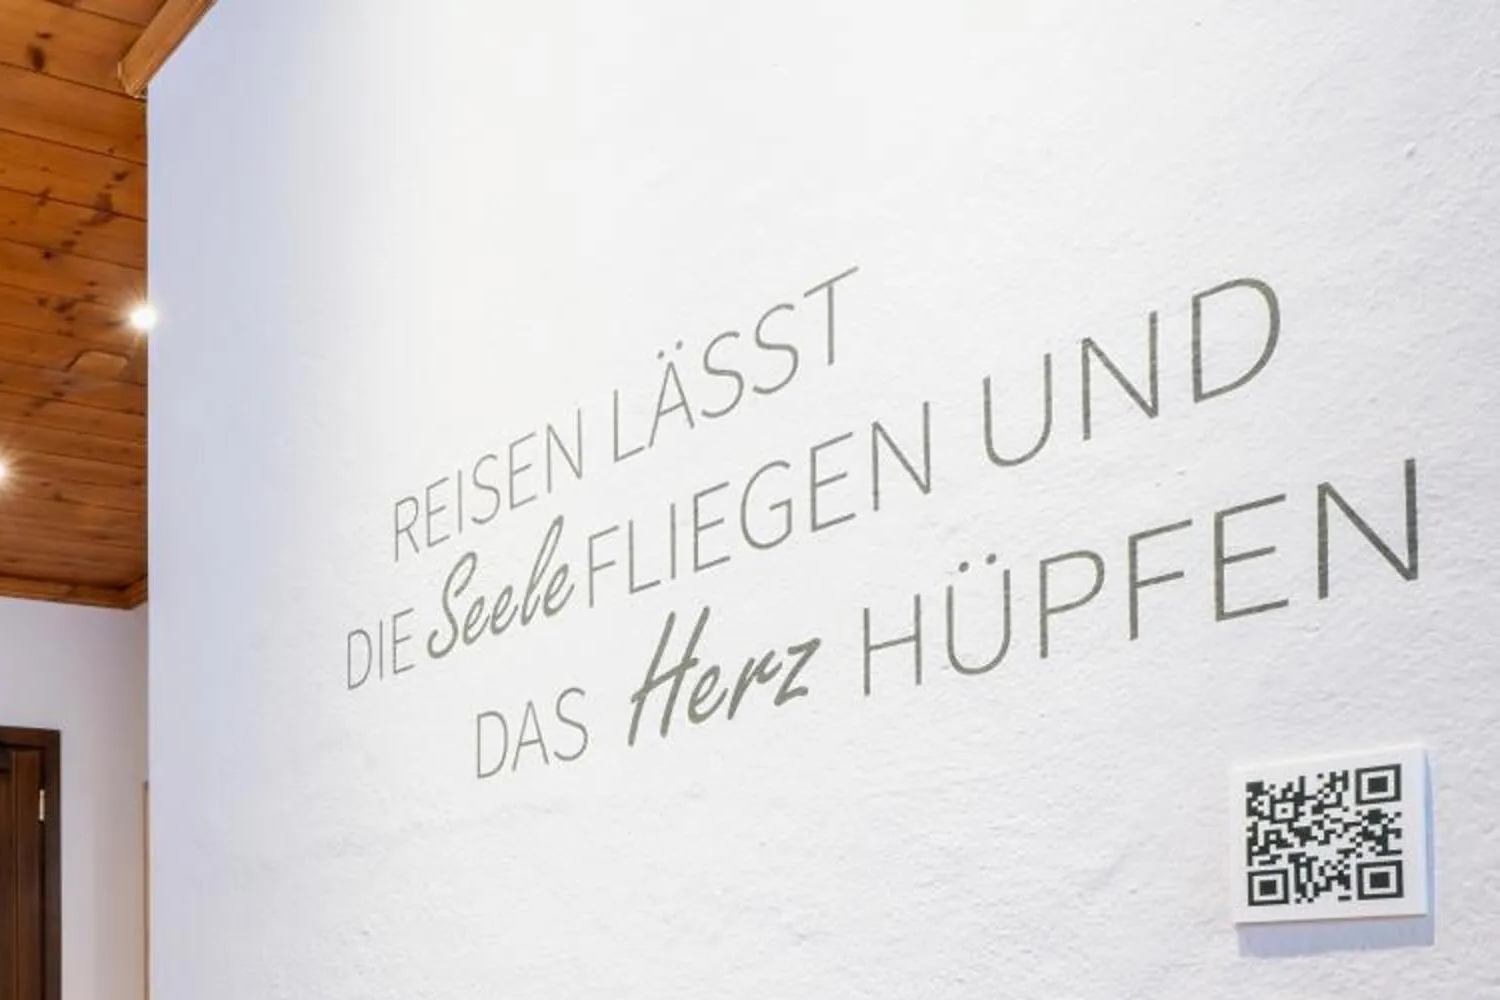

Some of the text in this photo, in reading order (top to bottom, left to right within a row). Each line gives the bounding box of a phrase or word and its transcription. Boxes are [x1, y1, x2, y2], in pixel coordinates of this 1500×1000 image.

[346, 277, 1282, 691] DIE Seele FLIEGEN UND
[393, 265, 860, 563] REISEN LÄSST
[476, 456, 1420, 780] DAS Herz HÜPFEN
